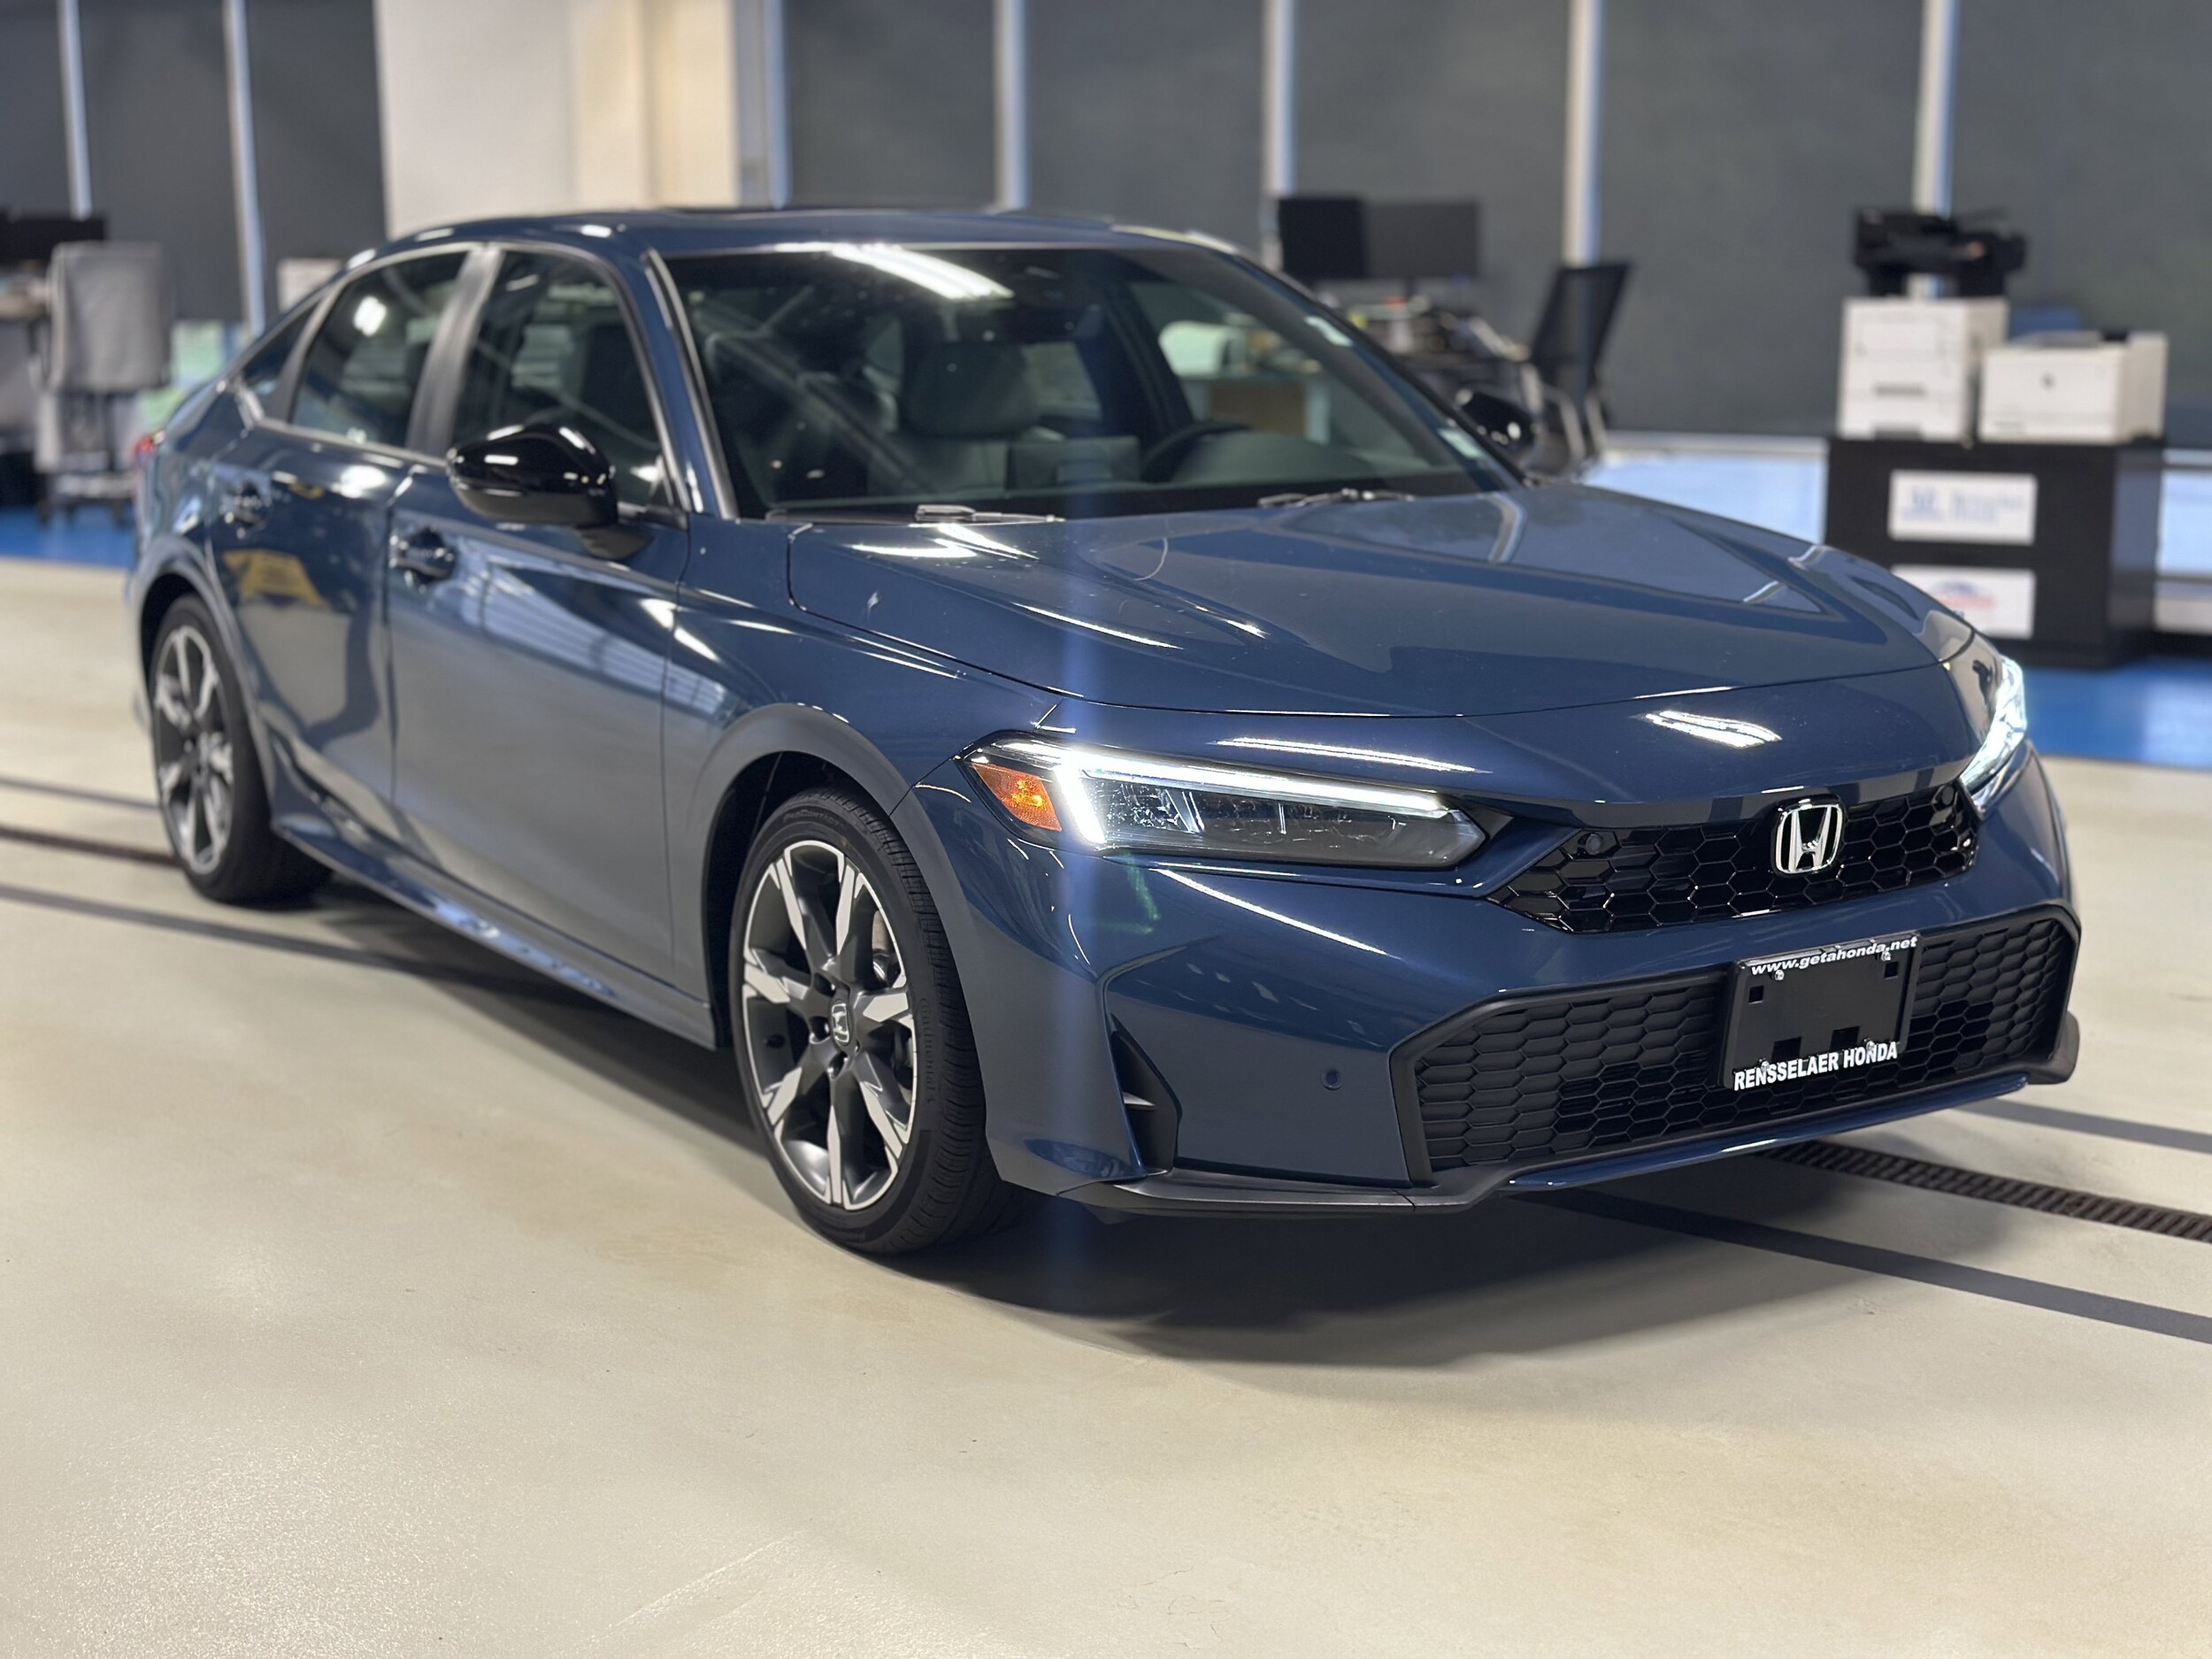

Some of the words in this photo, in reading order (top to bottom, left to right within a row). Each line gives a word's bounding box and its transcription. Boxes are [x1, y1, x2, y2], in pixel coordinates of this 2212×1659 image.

[1751, 936, 1918, 975] www.getahonda.net
[1733, 1051, 1839, 1091] RENSSELAER
[1843, 1041, 1898, 1069] HONDA
